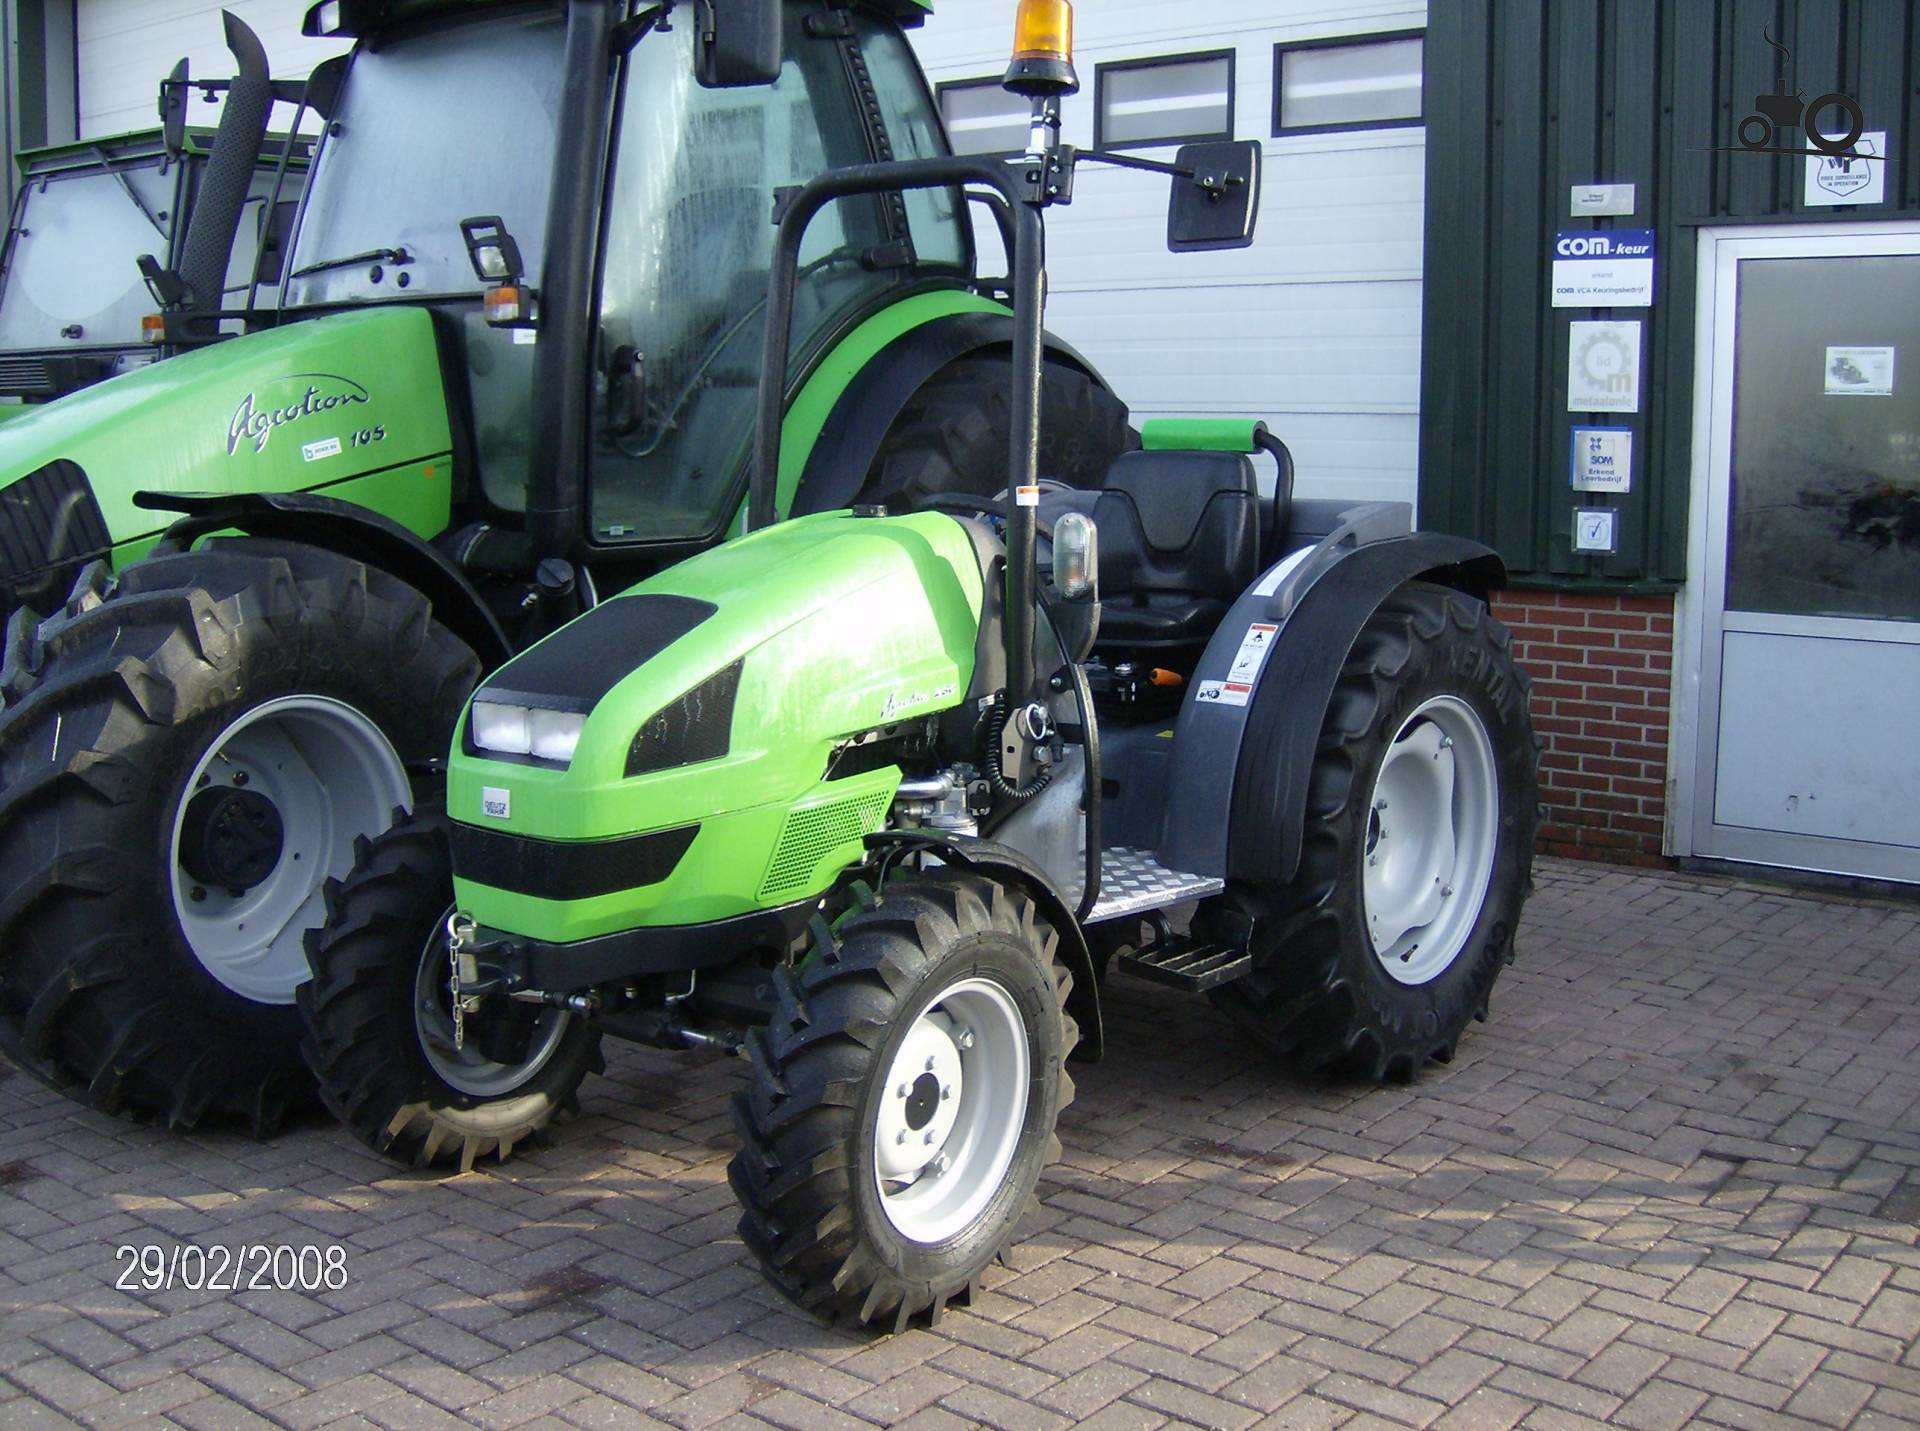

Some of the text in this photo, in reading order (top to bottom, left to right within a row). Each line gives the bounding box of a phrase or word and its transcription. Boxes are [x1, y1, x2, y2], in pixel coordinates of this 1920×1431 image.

[1592, 287, 1644, 296] Keuringsbedrijf
[1573, 395, 1632, 408] metaalunie
[227, 374, 370, 456] Agrotron
[350, 424, 387, 448] 105
[1591, 455, 1614, 466] SOM
[1581, 475, 1622, 484] Leerbedrijf
